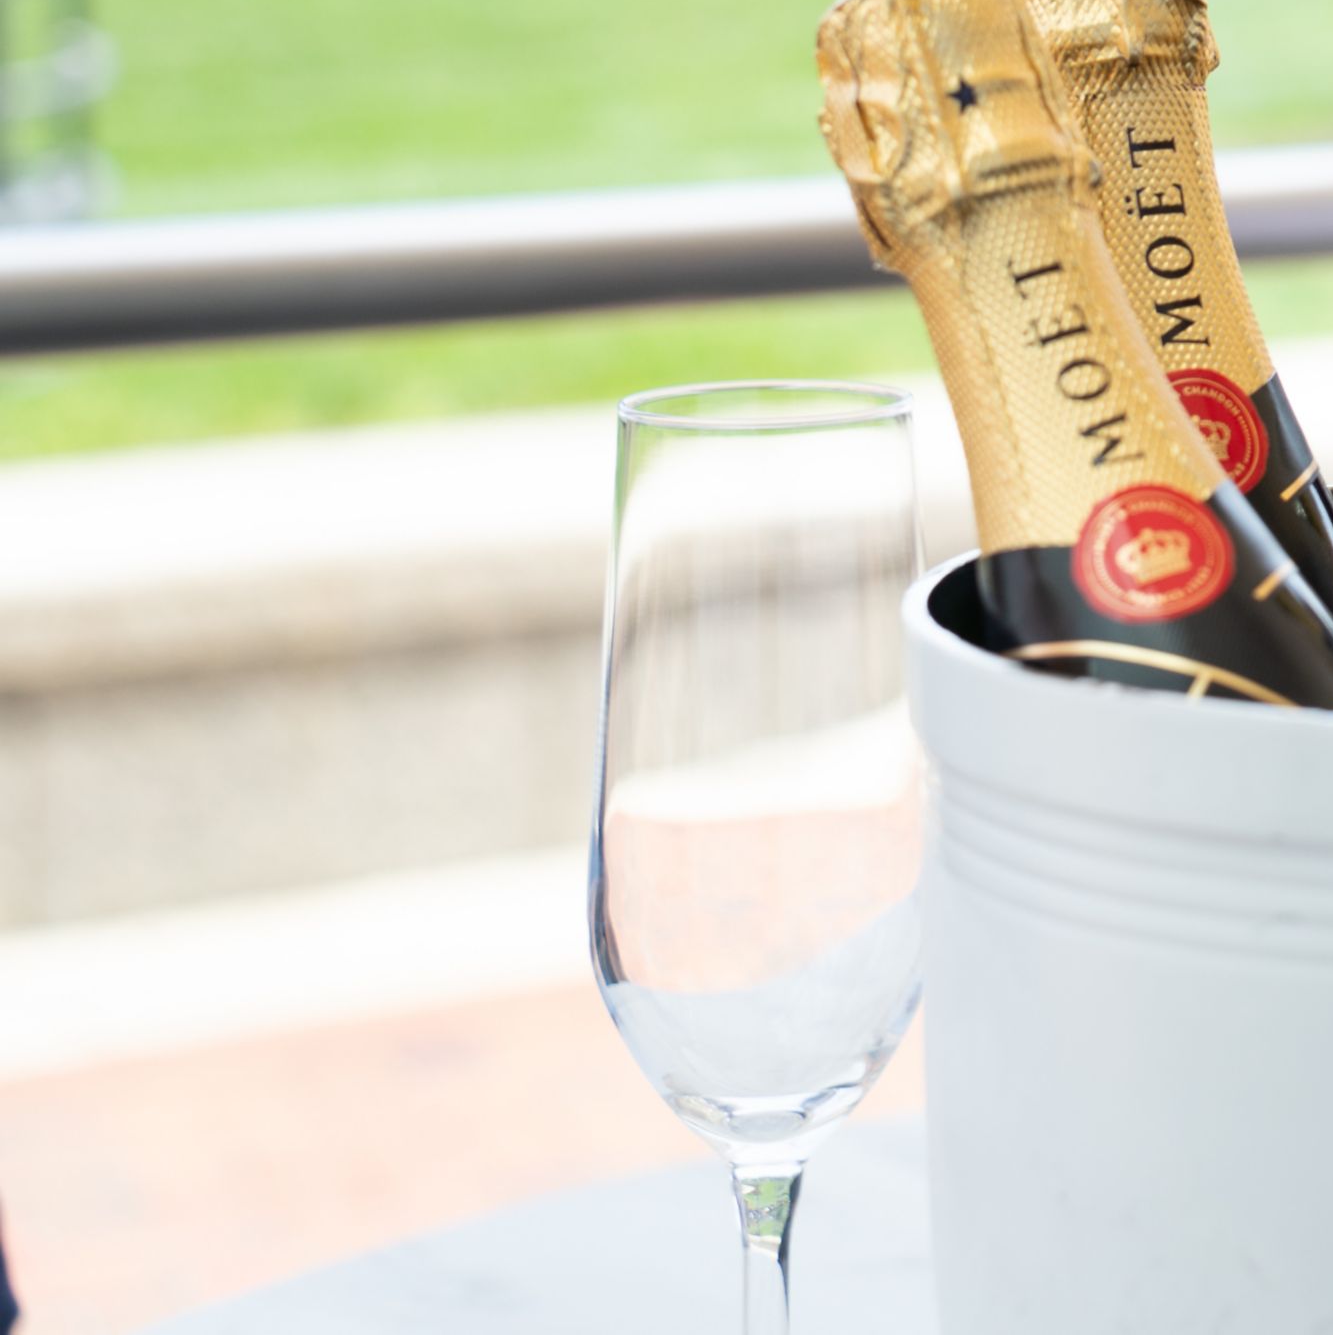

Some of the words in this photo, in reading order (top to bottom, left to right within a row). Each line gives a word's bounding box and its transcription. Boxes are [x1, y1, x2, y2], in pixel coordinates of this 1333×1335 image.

[1124, 127, 1210, 346] MOËT
[1007, 260, 1144, 467] MOËT
[1183, 385, 1240, 417] CHANDON
